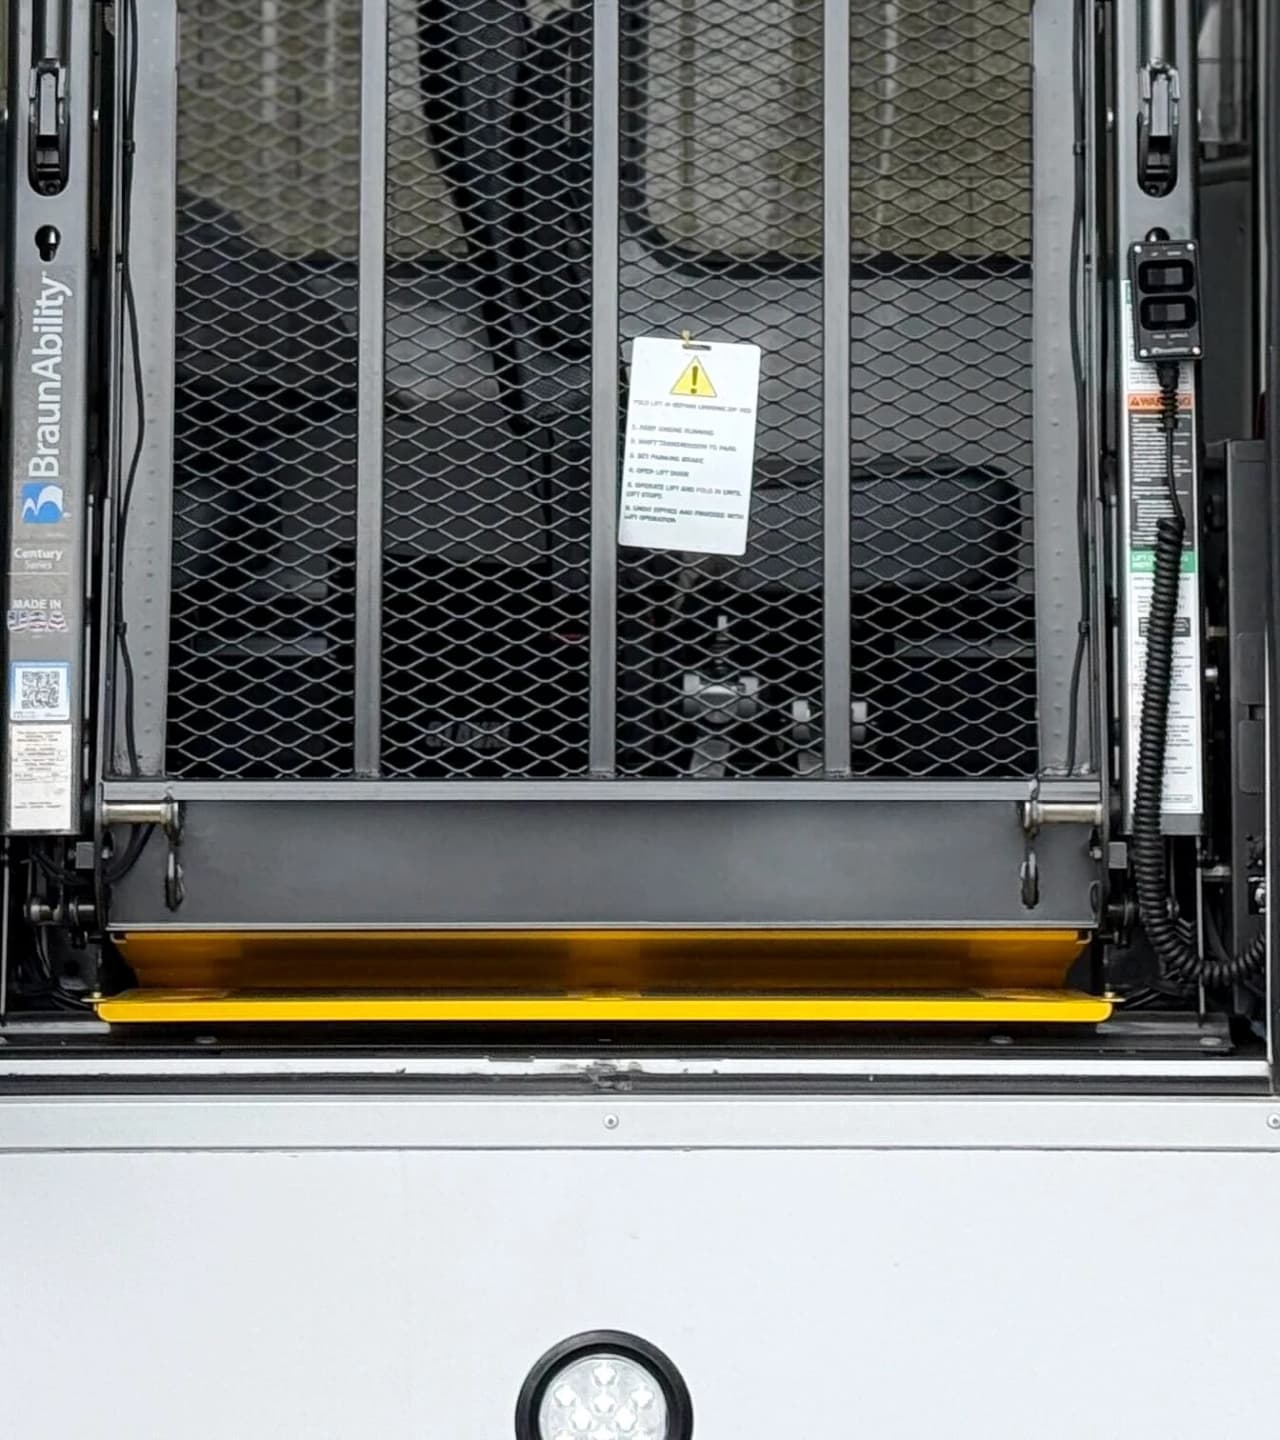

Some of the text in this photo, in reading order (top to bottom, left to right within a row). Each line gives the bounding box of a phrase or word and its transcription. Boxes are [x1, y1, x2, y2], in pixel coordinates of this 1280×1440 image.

[29, 276, 72, 478] BraunAbility
[13, 547, 63, 561] Century
[13, 599, 62, 609] MADE IN
[6, 610, 69, 633] USA
